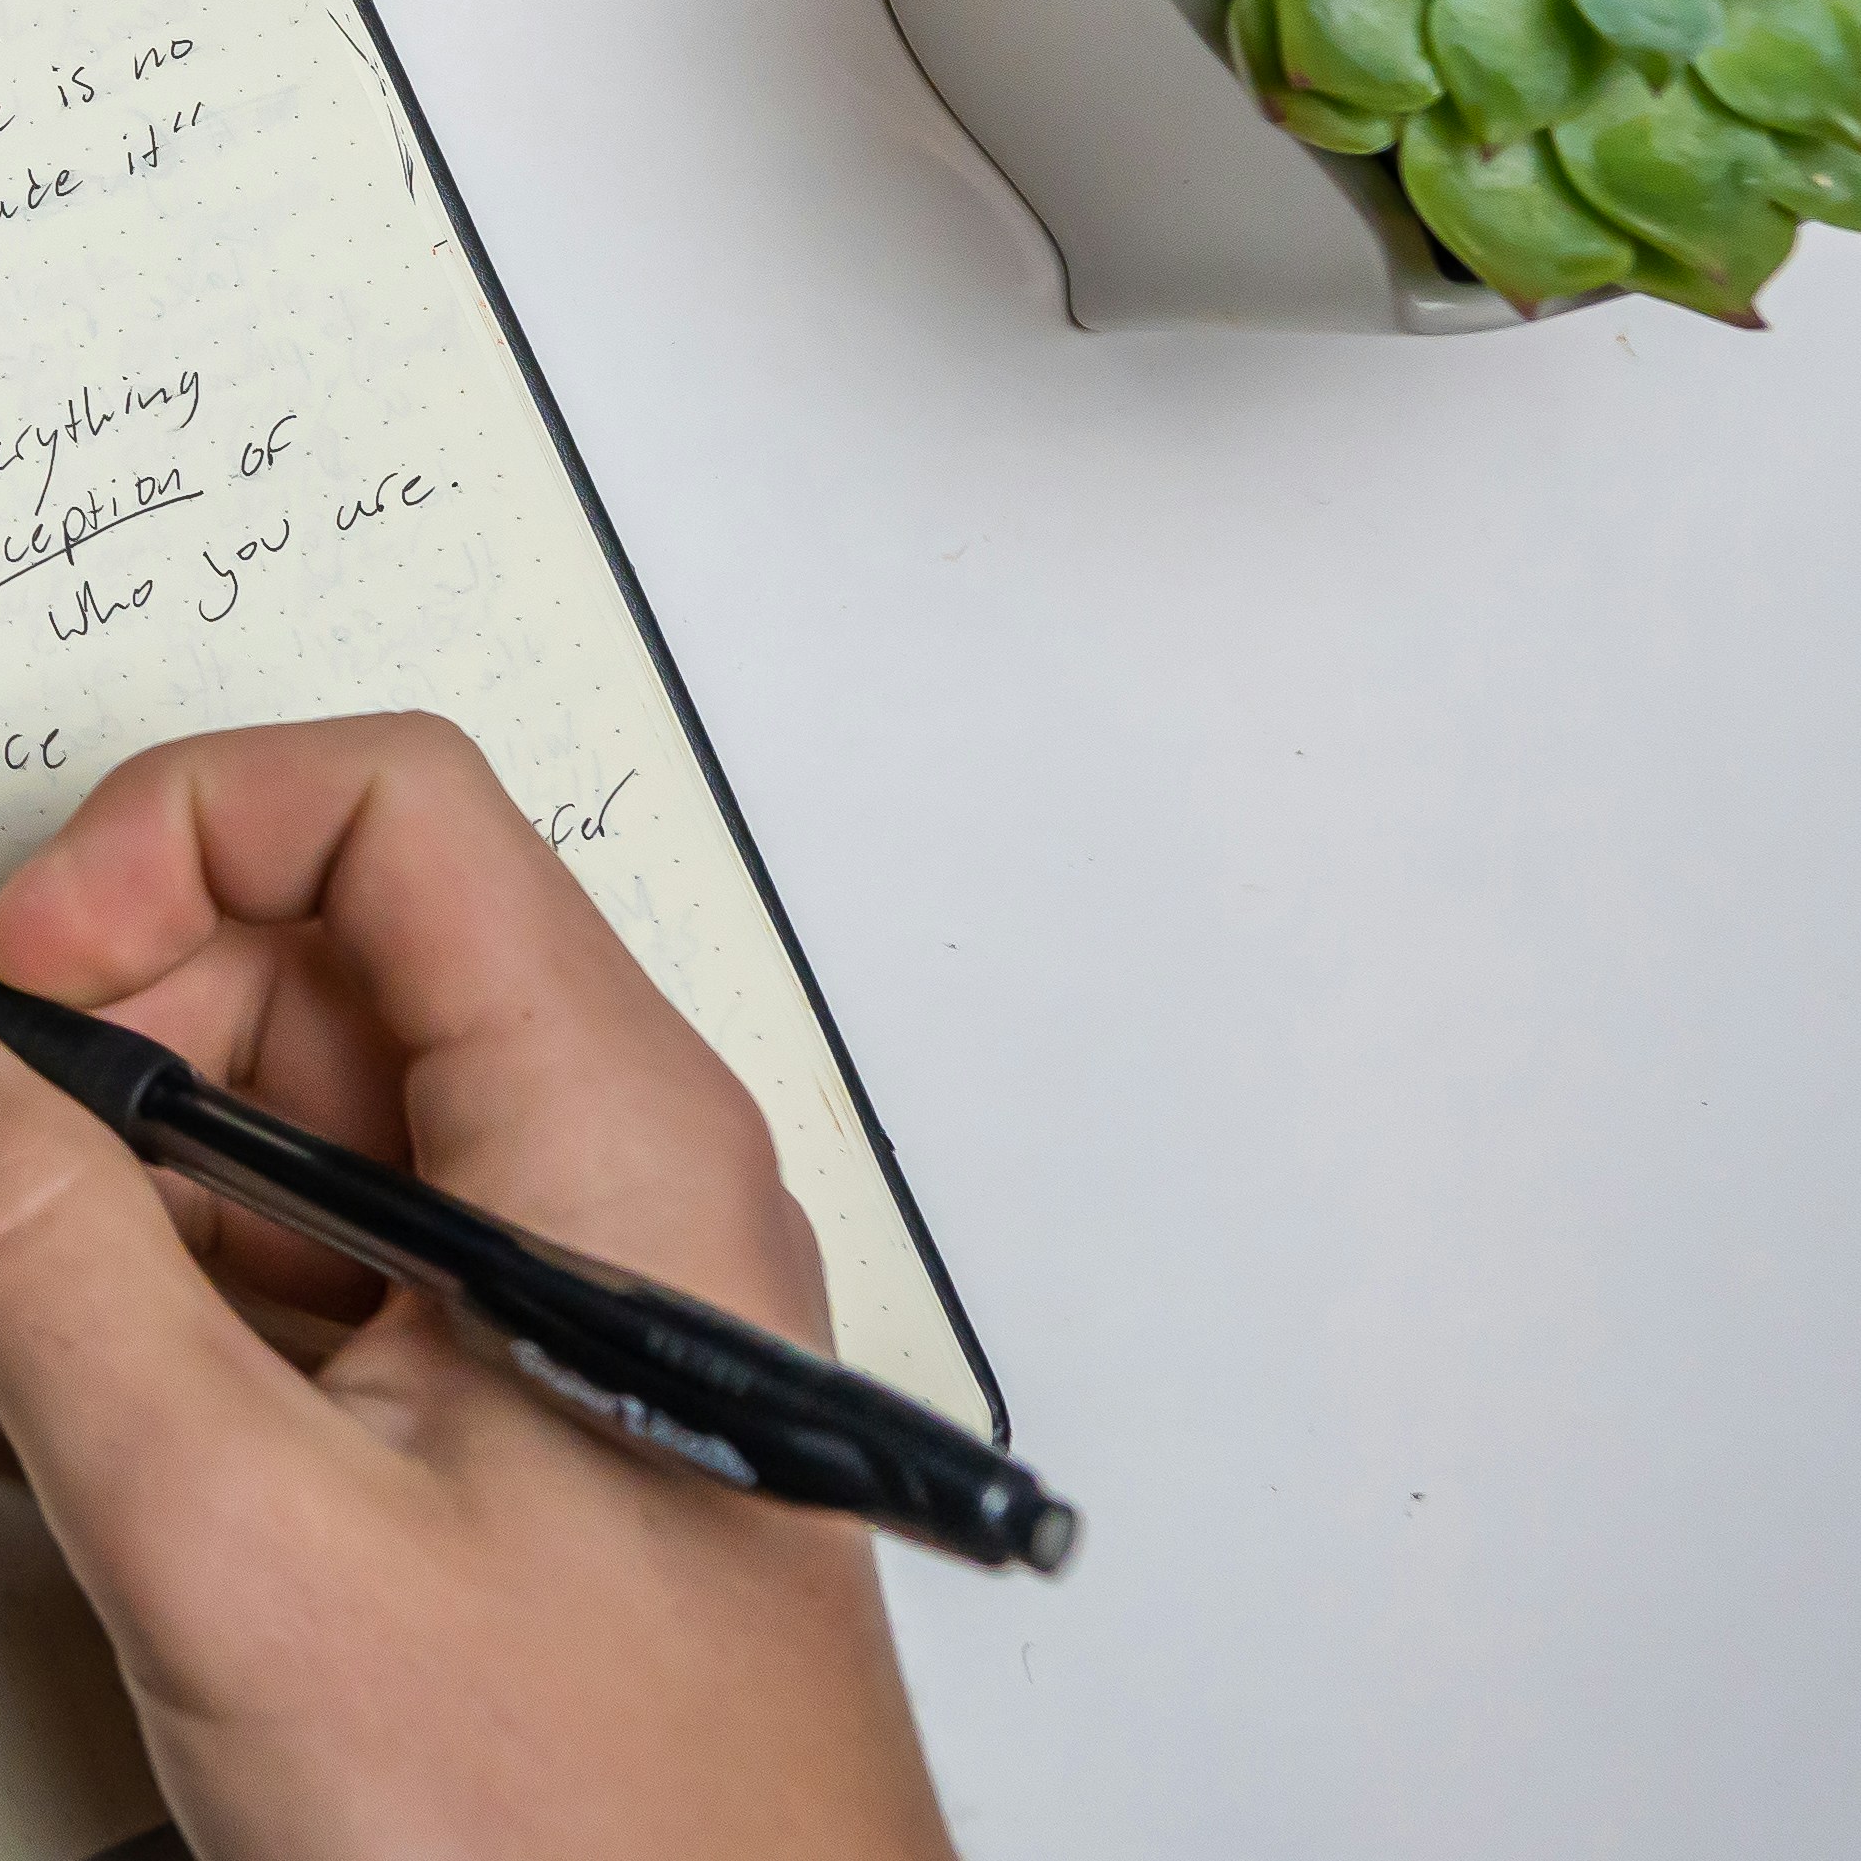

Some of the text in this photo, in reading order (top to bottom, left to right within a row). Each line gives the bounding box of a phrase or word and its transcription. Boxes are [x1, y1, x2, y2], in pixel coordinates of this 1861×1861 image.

[55, 57, 96, 107] is
[133, 37, 194, 82] no
[241, 413, 297, 478] of
[198, 522, 290, 624] you
[336, 469, 460, 533] are.
